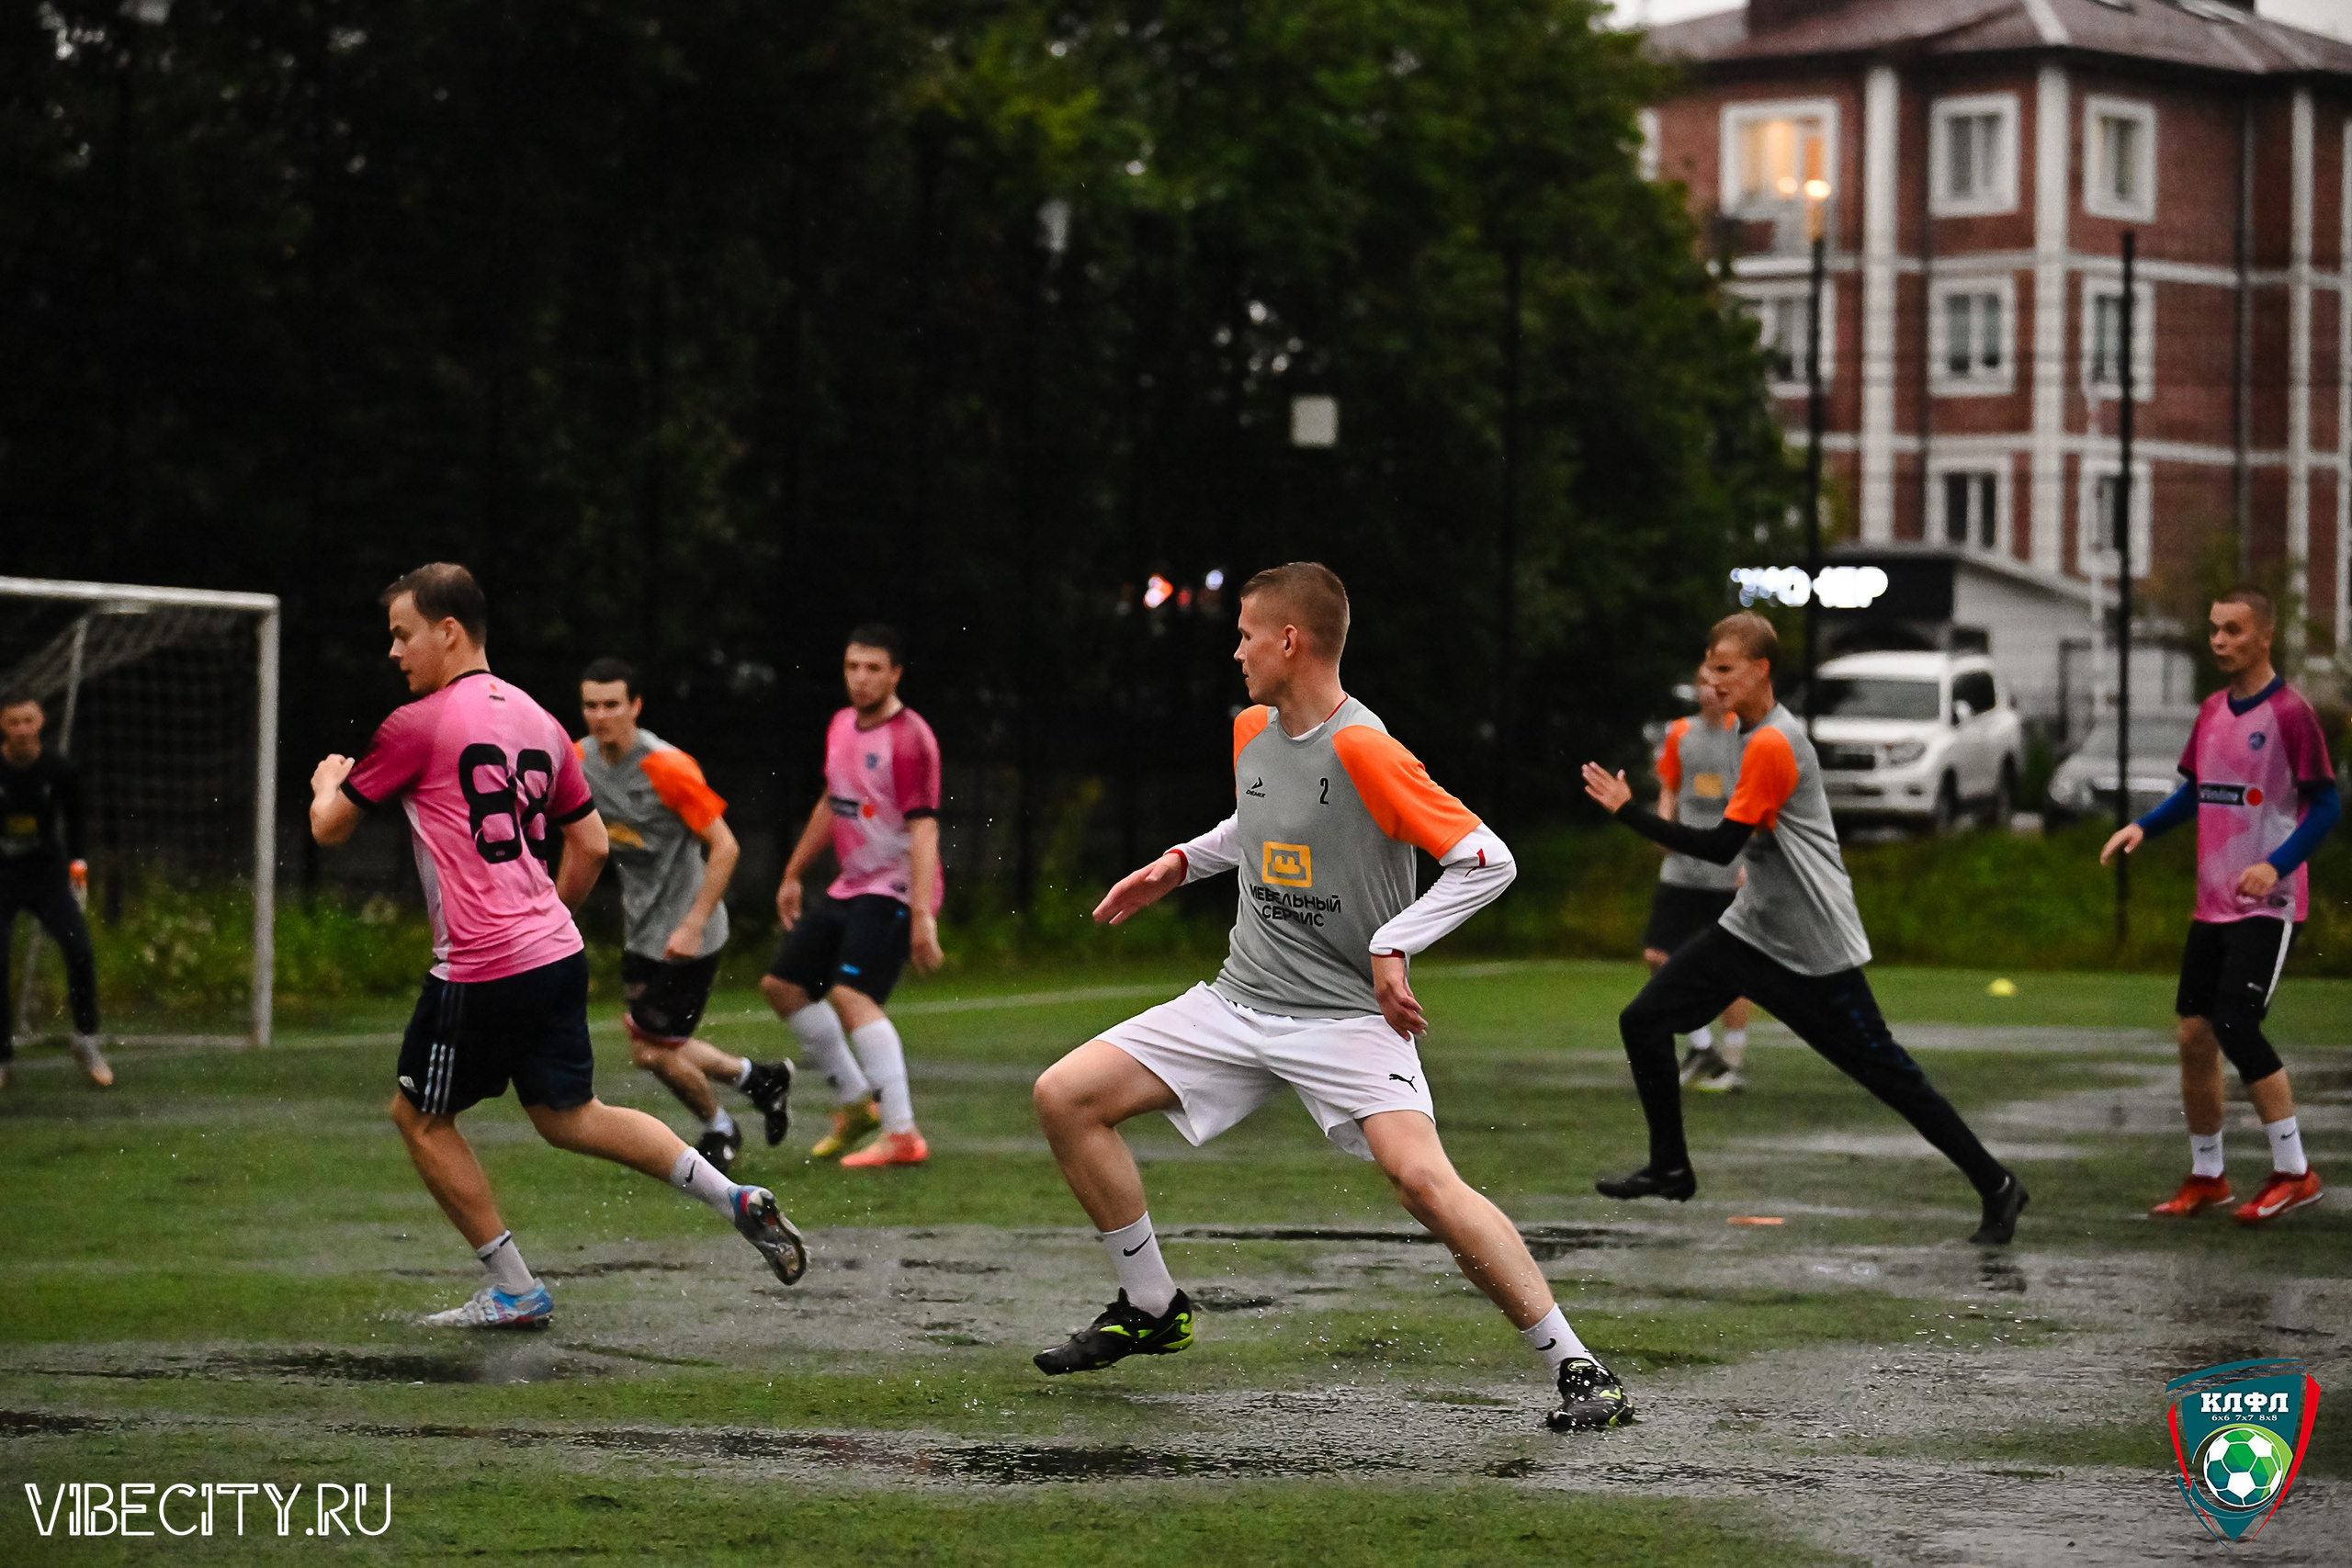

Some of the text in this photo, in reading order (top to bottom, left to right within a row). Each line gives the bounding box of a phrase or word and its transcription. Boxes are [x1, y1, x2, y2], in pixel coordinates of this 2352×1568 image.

[458, 743, 553, 863] 88
[1245, 789, 1266, 798] DEMIX
[1318, 777, 1329, 805] 2
[1261, 905, 1324, 928] СЕРВИС
